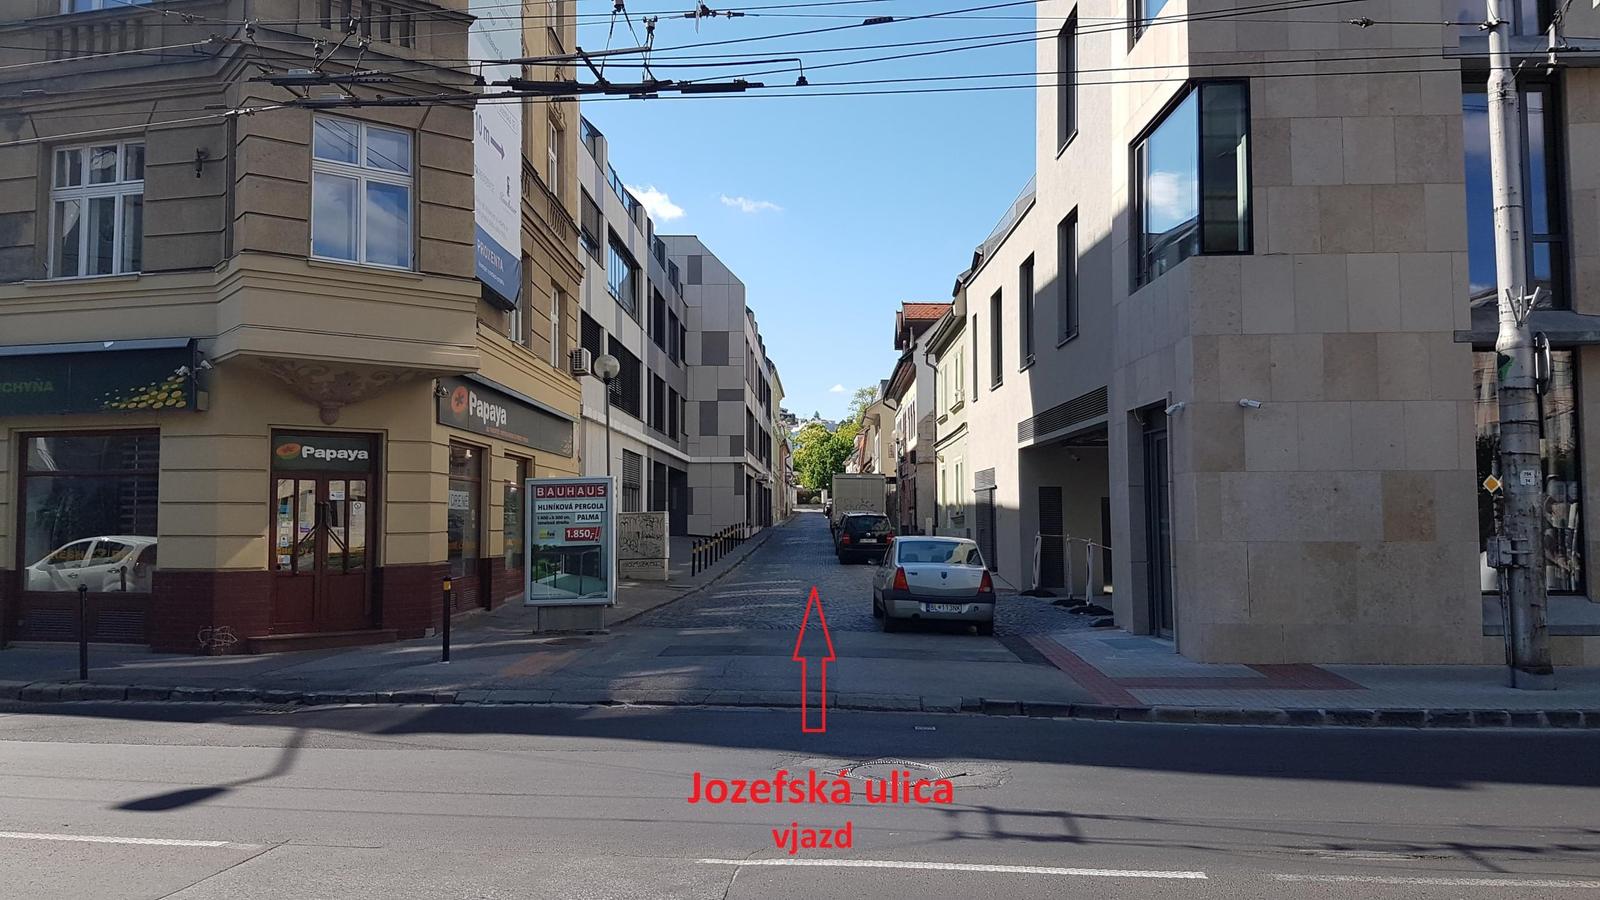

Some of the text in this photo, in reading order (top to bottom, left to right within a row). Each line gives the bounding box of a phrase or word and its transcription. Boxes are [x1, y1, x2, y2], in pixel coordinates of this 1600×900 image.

[0, 377, 55, 393] CHYŇA
[468, 389, 507, 427] Papaya
[301, 445, 369, 462] Papaya
[536, 486, 605, 497] BAUHAUS
[537, 502, 604, 511] HLINÍKOVÁ PERGOLA
